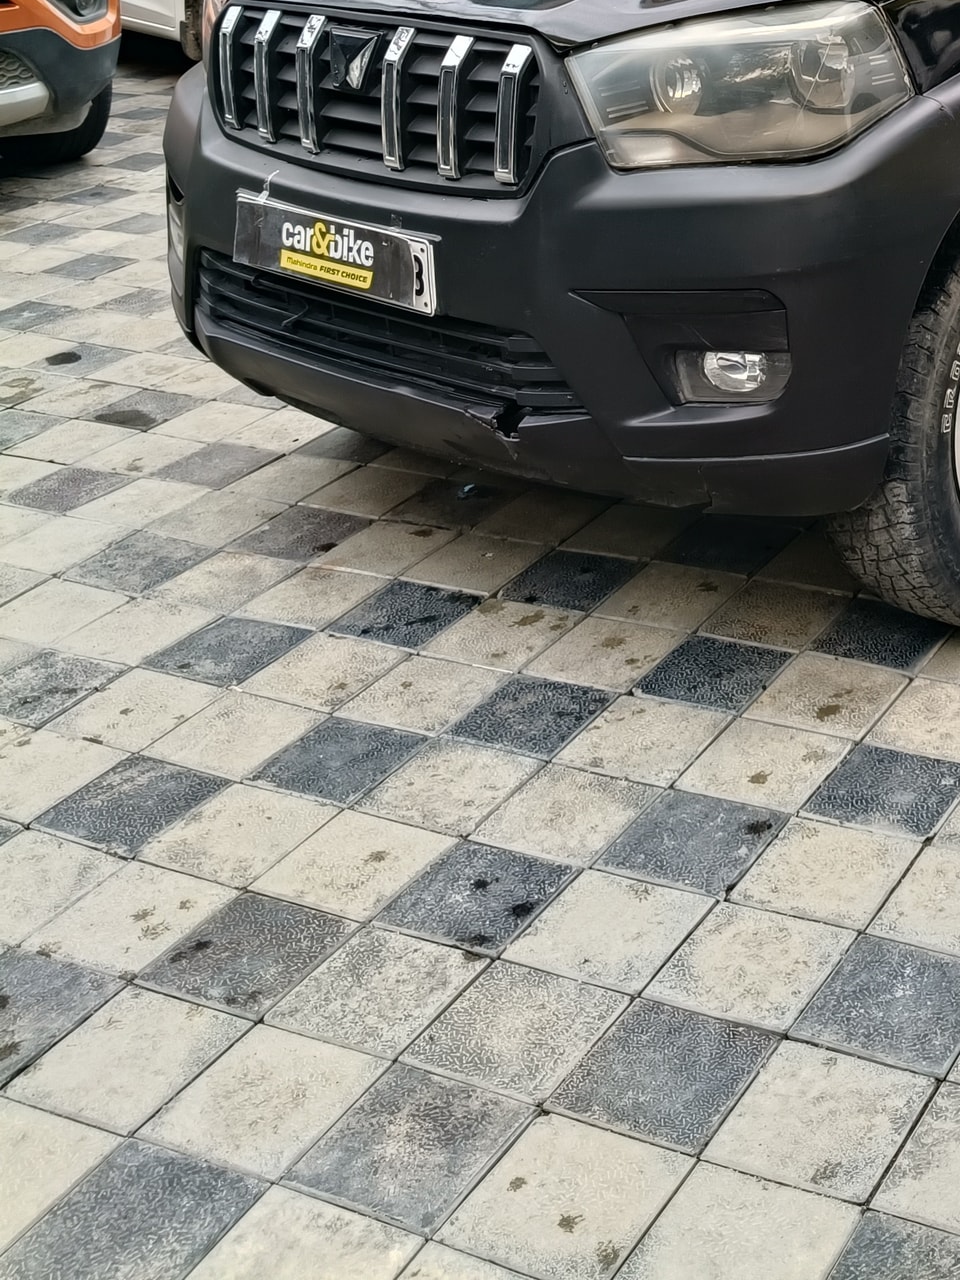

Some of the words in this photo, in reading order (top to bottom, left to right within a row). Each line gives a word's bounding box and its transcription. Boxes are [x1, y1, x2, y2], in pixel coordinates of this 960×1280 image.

[281, 222, 374, 267] car&bike
[286, 256, 318, 271] Mahindra
[319, 265, 341, 277] FIRST
[341, 270, 368, 283] CHOICE
